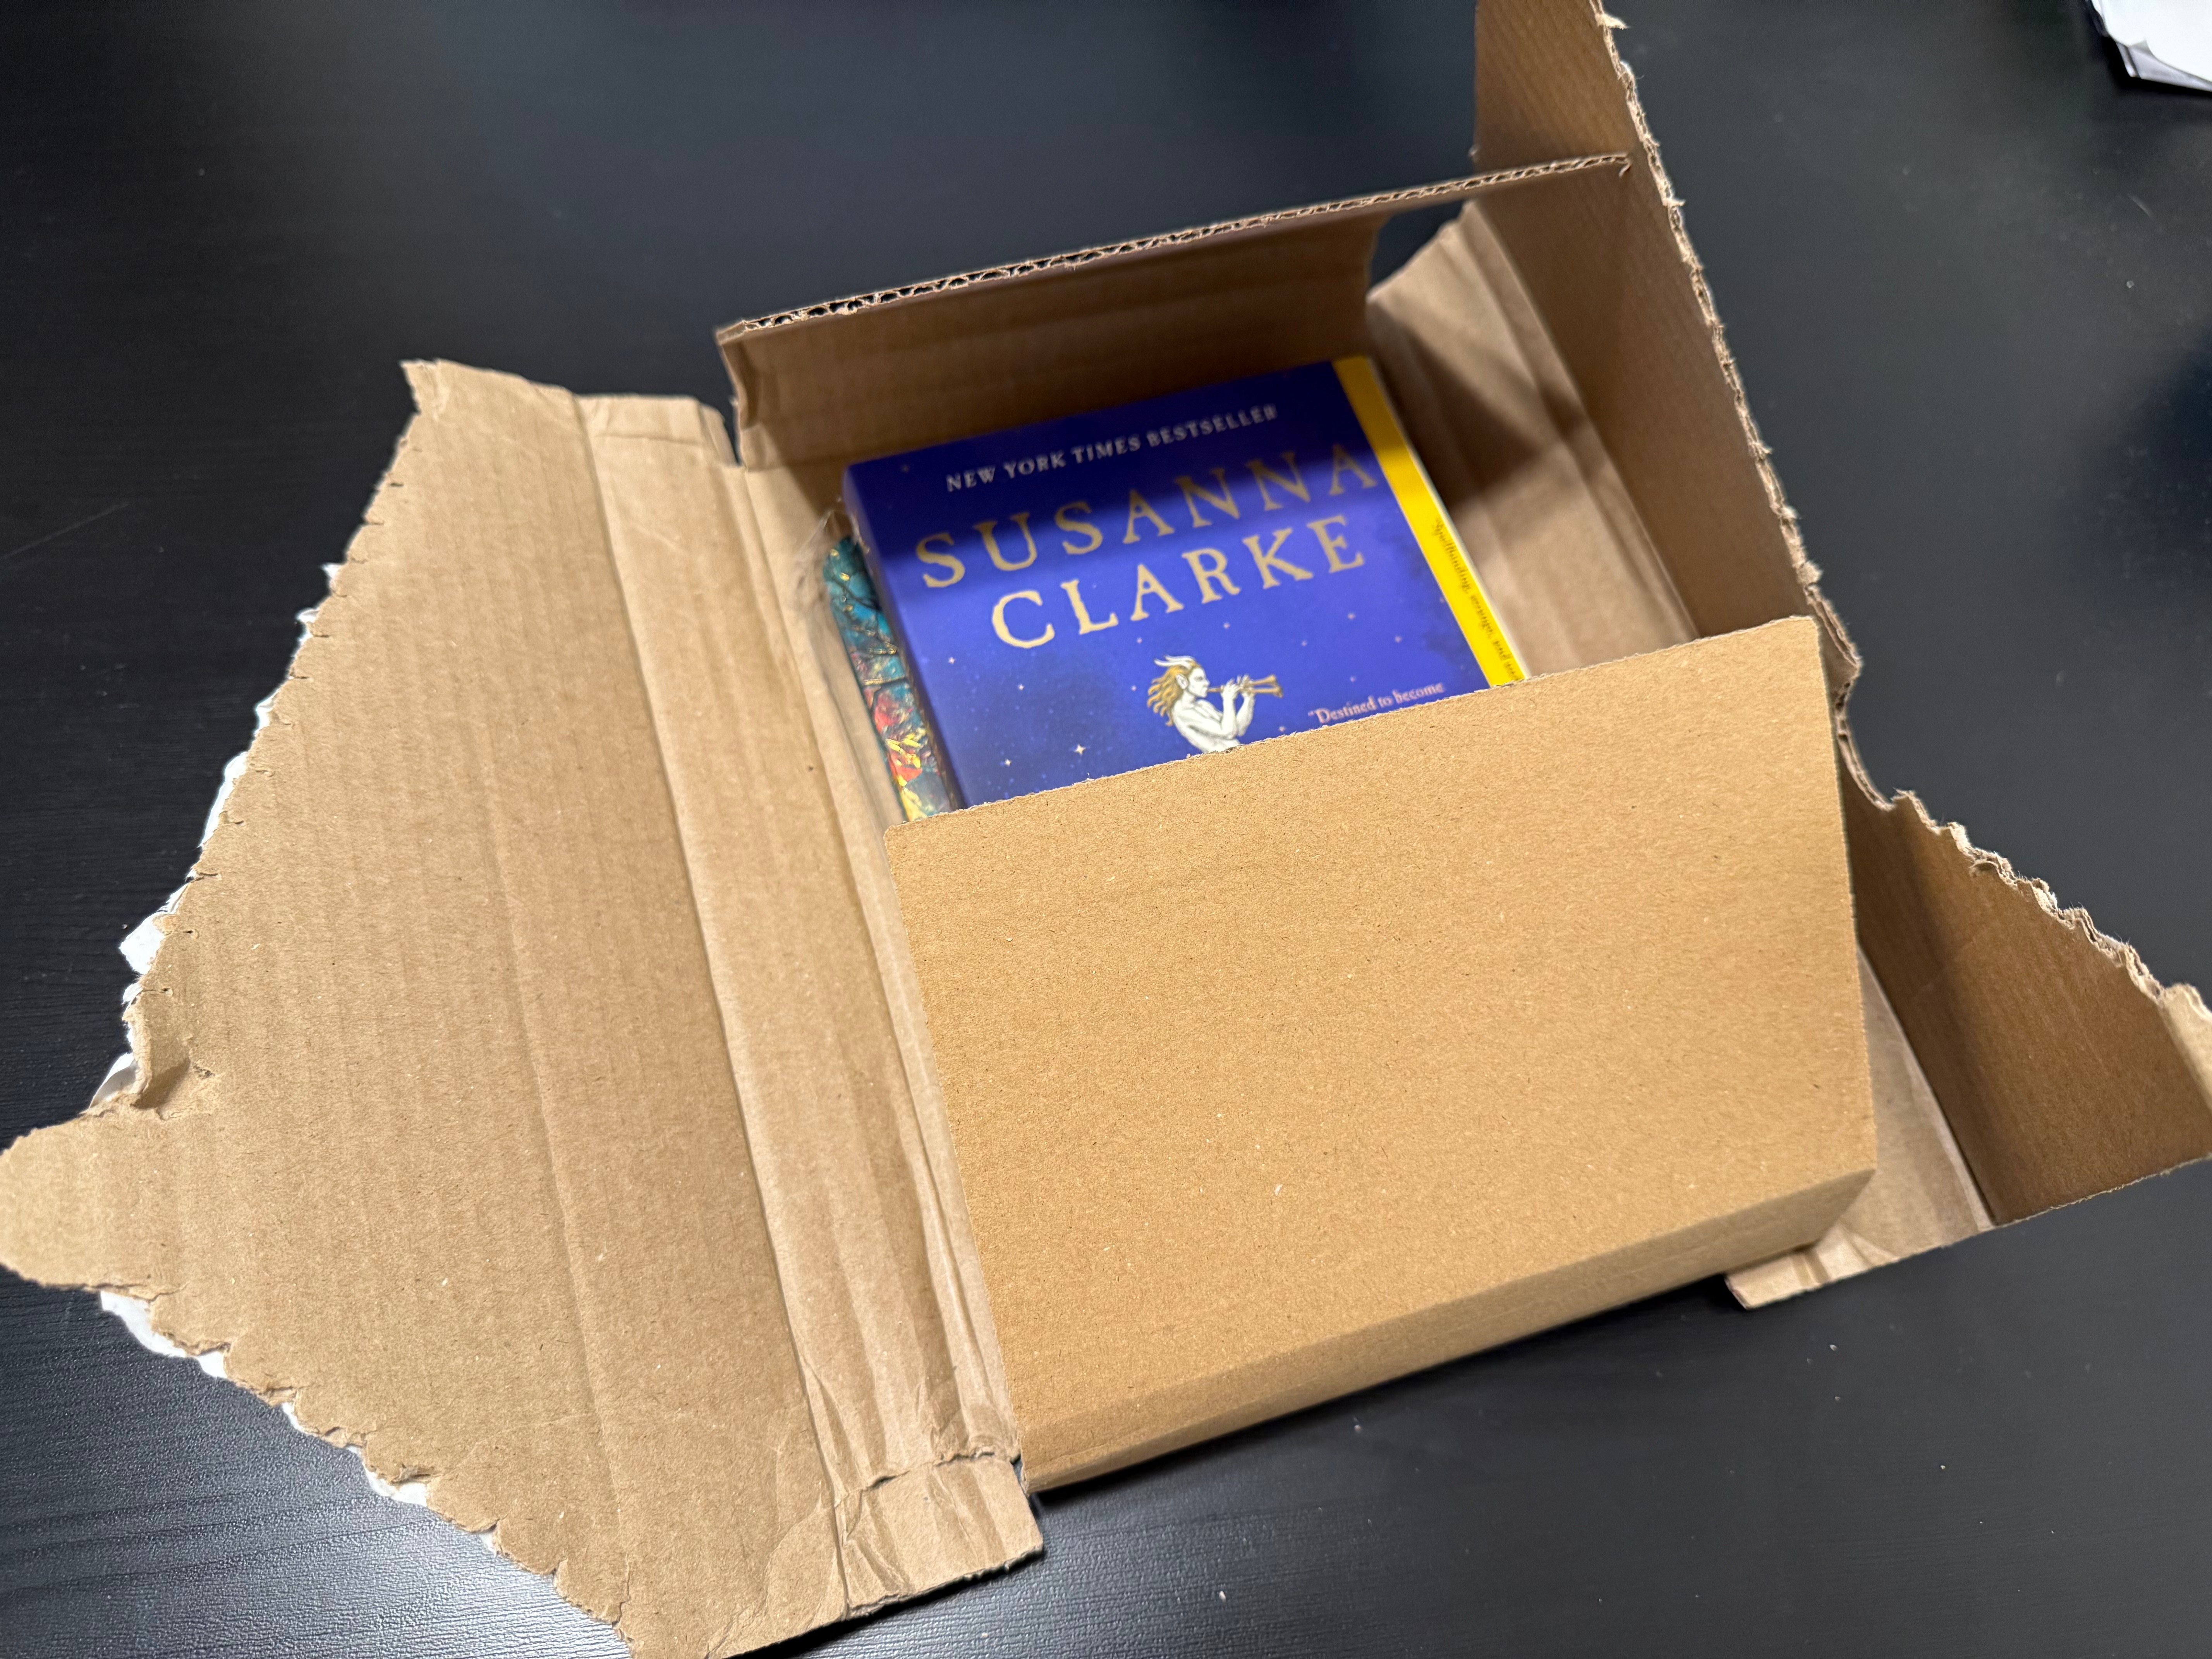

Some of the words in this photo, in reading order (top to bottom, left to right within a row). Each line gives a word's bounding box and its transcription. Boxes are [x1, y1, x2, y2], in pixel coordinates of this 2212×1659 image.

[946, 466, 996, 492] NEW
[1003, 450, 1066, 479] YORK
[1070, 434, 1141, 464] TIMES
[1146, 403, 1278, 447] BESTSELLER
[915, 444, 1377, 588] SUSANNA
[992, 515, 1365, 649] CLARKE
[1308, 695, 1377, 723] “Destined
[1377, 695, 1393, 708] to
[1393, 683, 1444, 704] become
